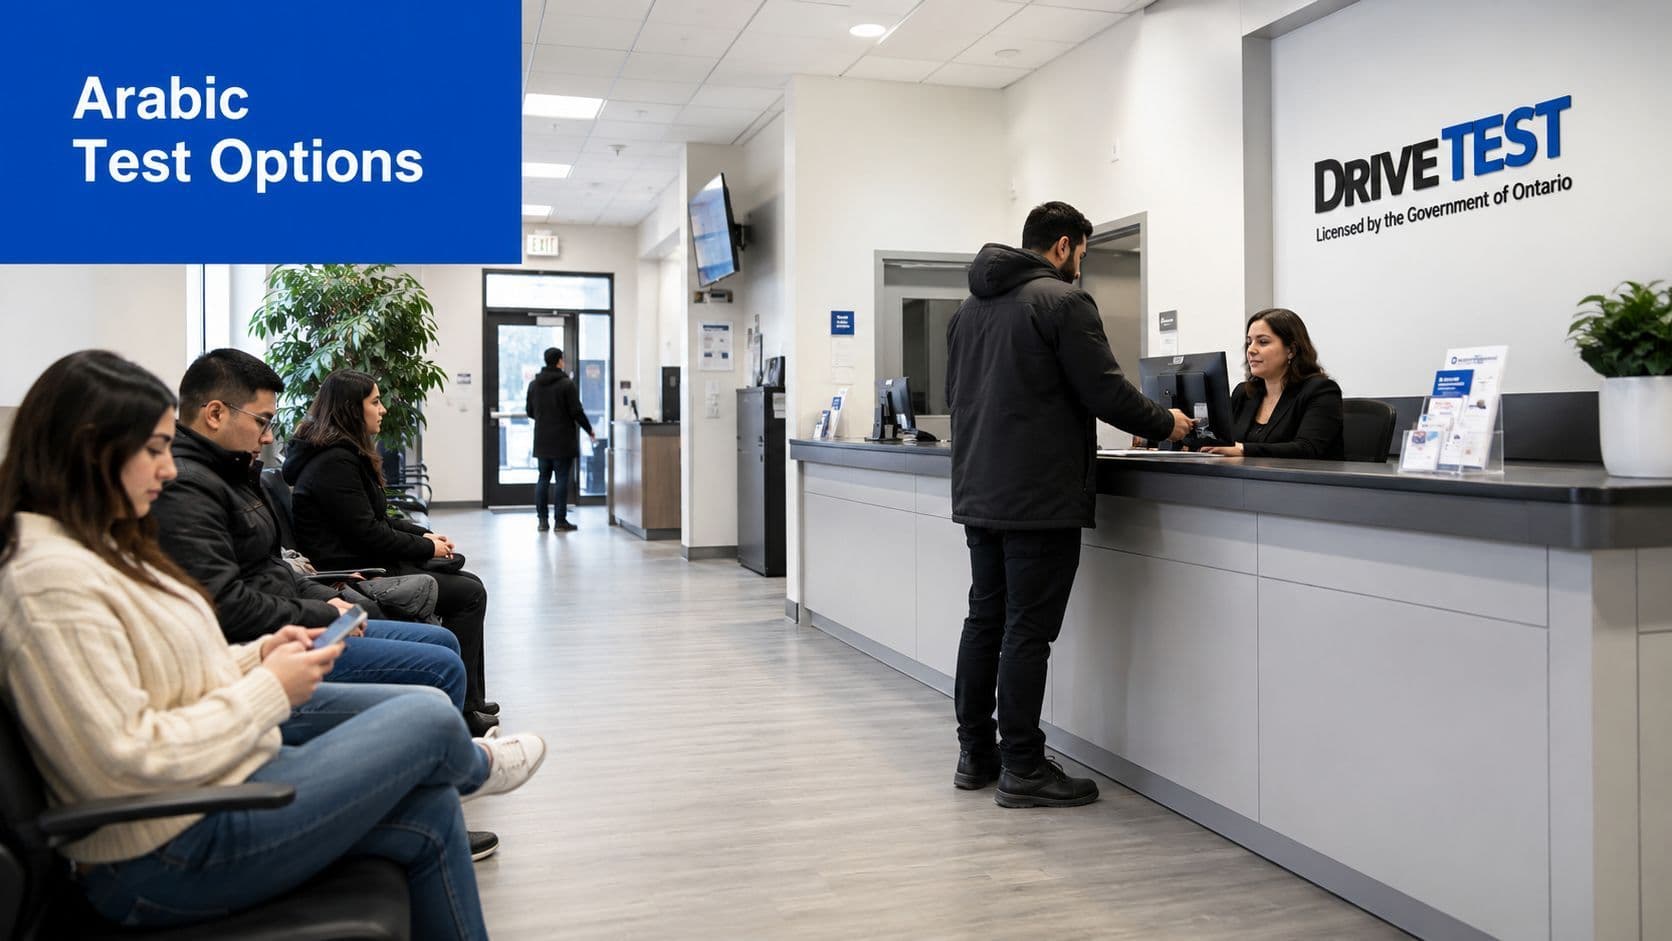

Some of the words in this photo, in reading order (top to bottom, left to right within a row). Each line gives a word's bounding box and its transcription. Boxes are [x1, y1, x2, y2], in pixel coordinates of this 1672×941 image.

[1316, 217, 1364, 242] Licensed
[1367, 216, 1381, 234] by
[1384, 211, 1404, 228] the
[1408, 191, 1490, 223] Government
[1493, 185, 1509, 205] of
[1512, 173, 1573, 200] Ontario
